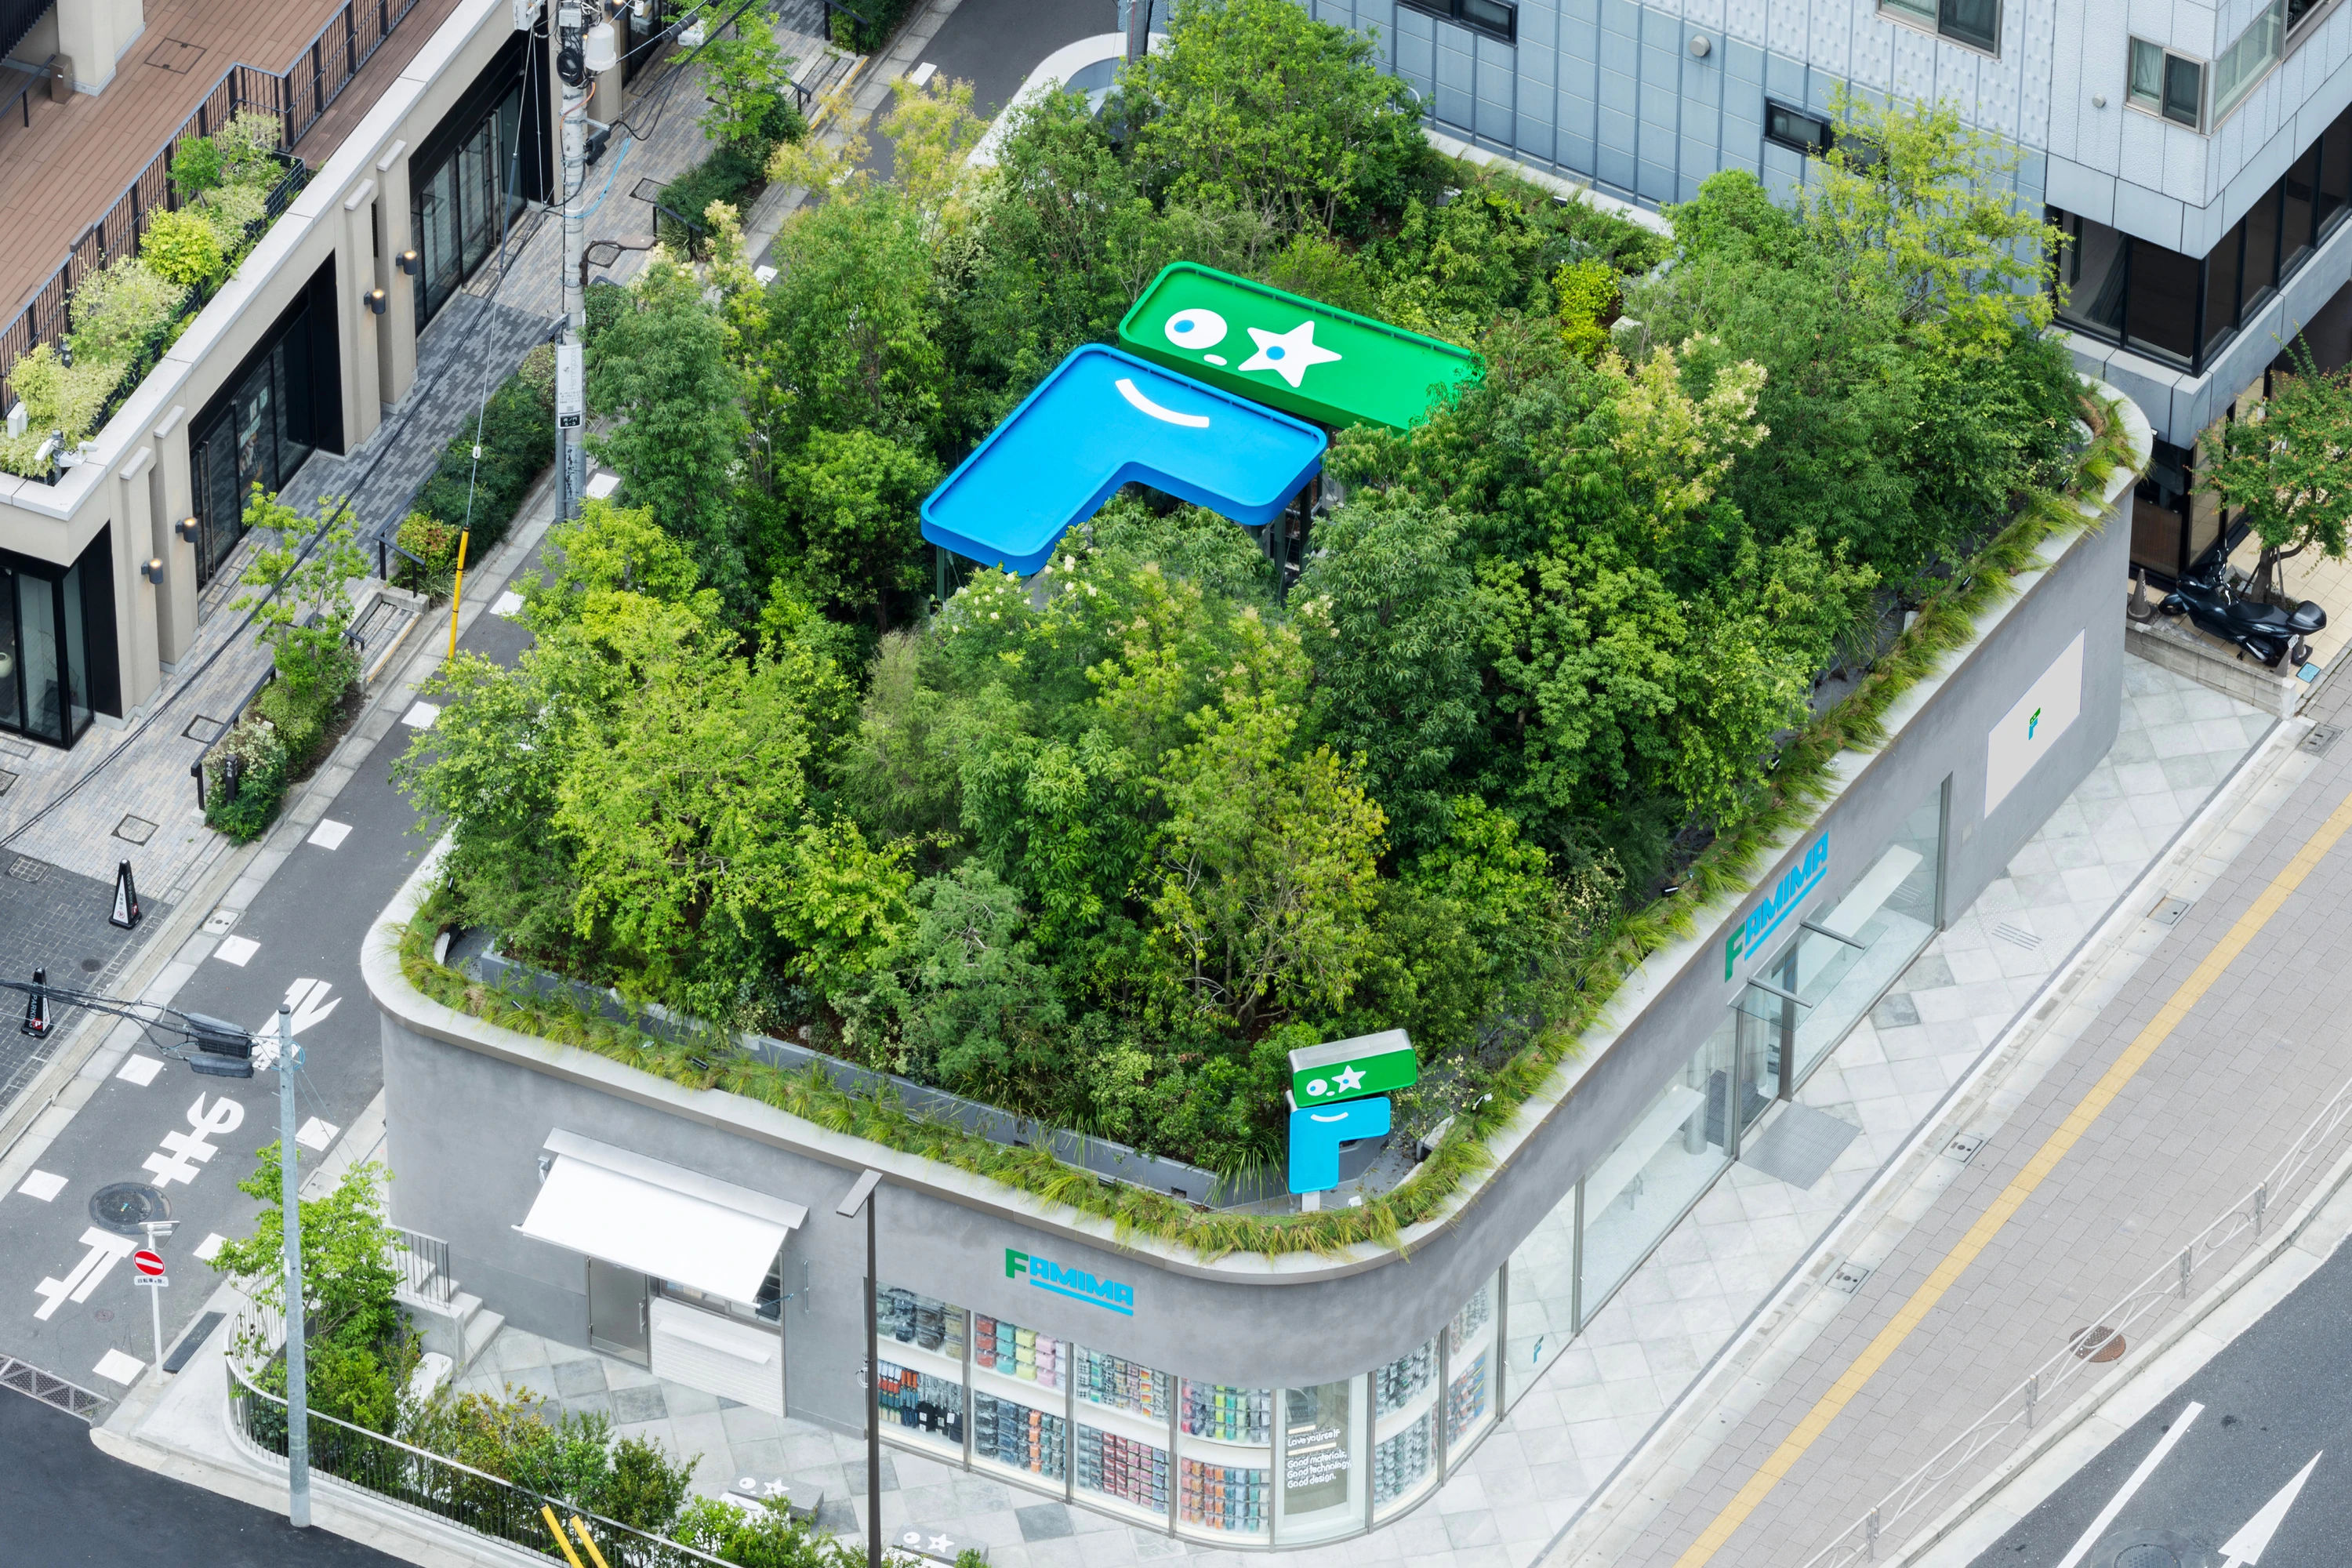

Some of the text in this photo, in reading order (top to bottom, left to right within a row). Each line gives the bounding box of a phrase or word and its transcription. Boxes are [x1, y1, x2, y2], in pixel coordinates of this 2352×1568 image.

[1725, 830, 1828, 984] FAMIMA
[1006, 1248, 1134, 1306] FAMIMA
[1288, 1437, 1307, 1447] Love
[1287, 1457, 1308, 1468] Good
[1287, 1467, 1308, 1479] Good
[1287, 1472, 1337, 1489] Good design.
